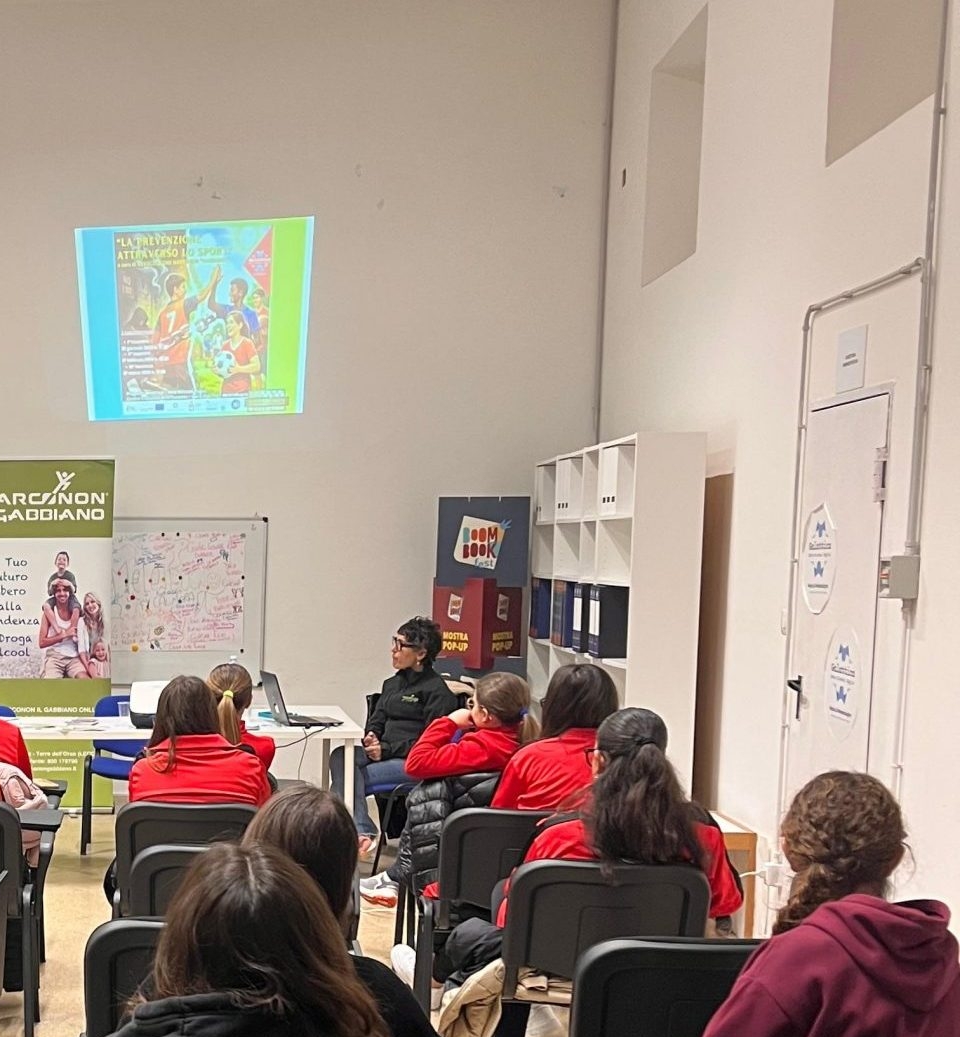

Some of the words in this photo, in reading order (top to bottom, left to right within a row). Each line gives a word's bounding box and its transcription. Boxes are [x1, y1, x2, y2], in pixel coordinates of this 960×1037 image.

[462, 526, 498, 543] BOOM
[462, 542, 497, 559] BOOK
[5, 557, 28, 567] Tuo
[442, 631, 469, 641] MOSTRA
[442, 641, 469, 651] POP-UP
